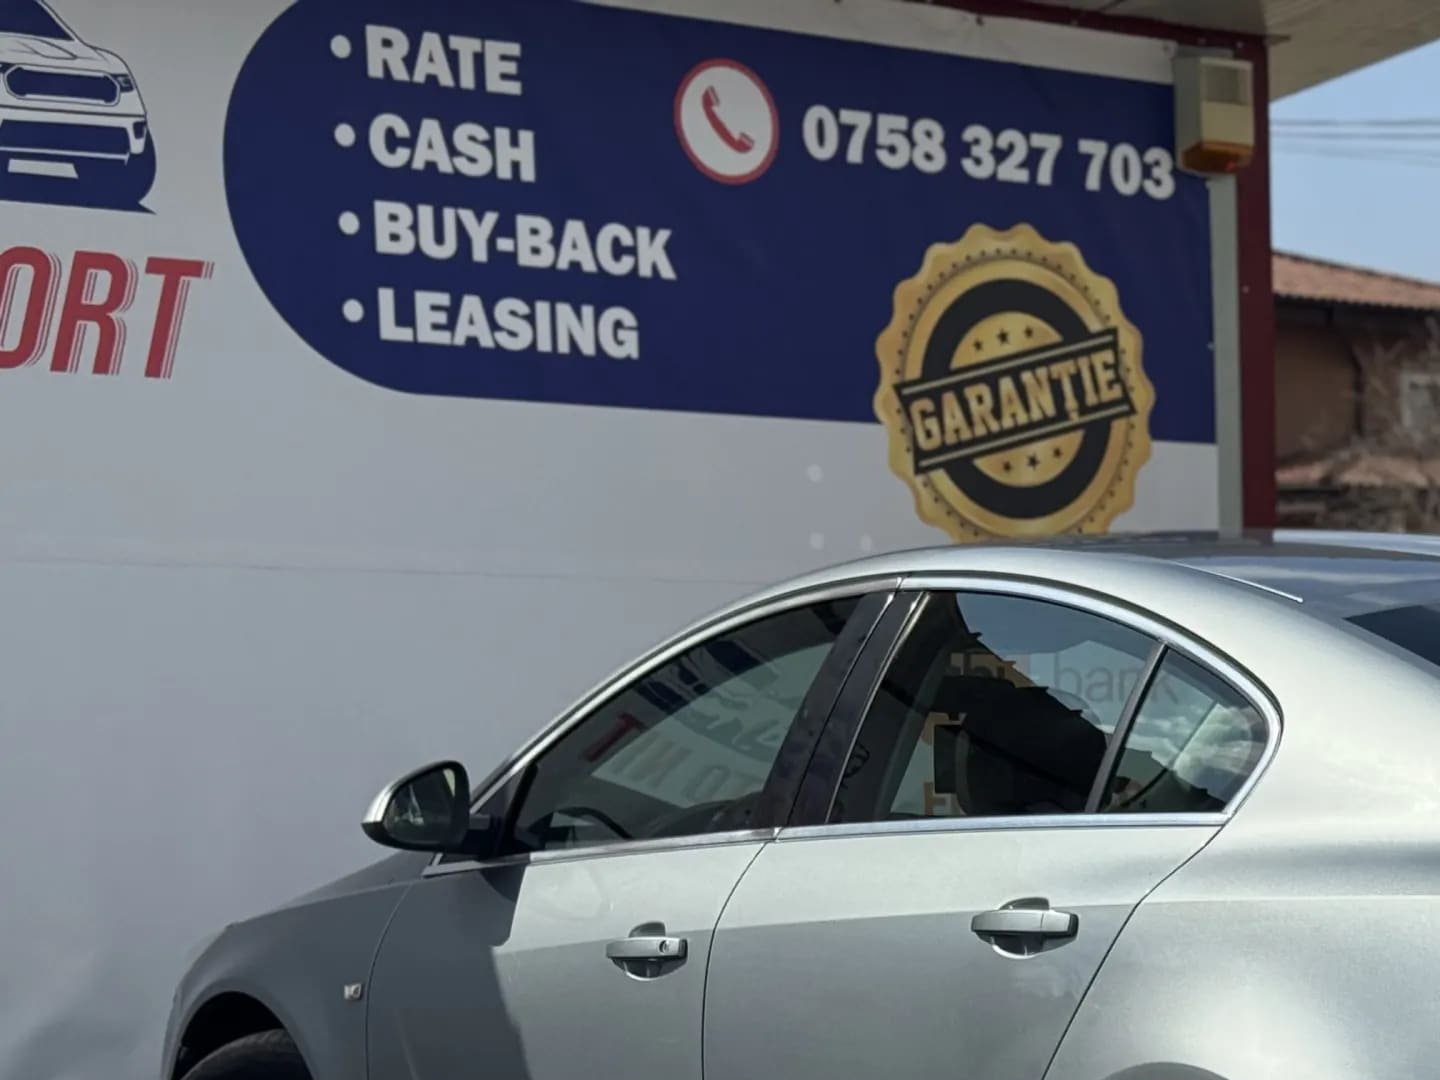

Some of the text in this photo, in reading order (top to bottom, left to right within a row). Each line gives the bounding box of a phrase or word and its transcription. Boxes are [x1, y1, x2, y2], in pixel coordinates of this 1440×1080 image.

[365, 23, 522, 96] RATE
[368, 112, 536, 183] CASH
[802, 104, 1176, 200] 0758 327 703
[373, 199, 677, 281] BUY-BACK
[377, 286, 640, 361] LEASING
